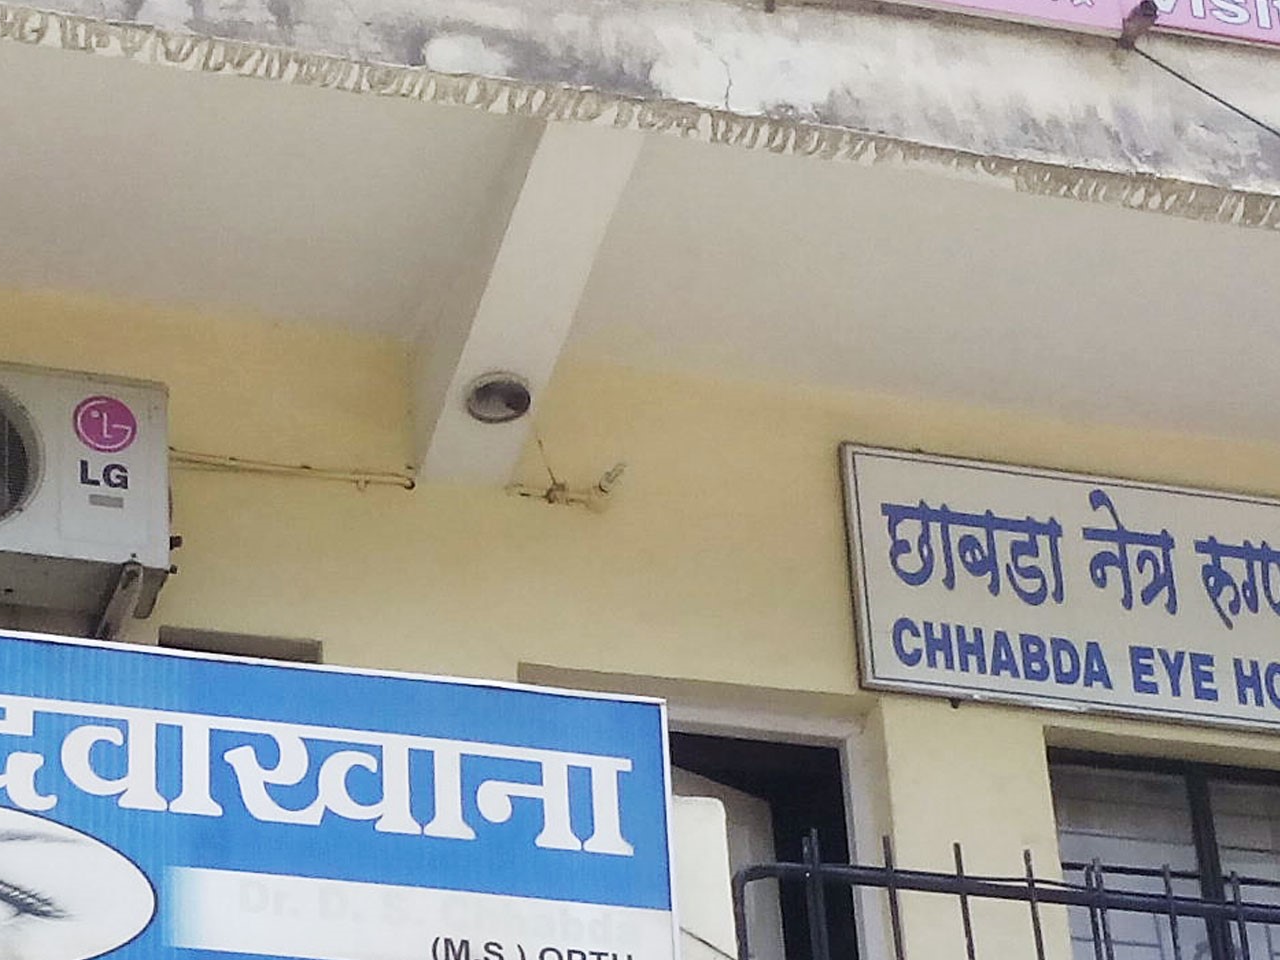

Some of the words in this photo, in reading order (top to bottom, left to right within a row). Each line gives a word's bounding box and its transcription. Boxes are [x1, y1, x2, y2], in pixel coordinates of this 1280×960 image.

[79, 459, 130, 490] LG
[881, 499, 1064, 606] छाबडा
[1083, 489, 1179, 615] नेत्र
[892, 617, 1113, 691] CHHABDA
[1129, 645, 1219, 702] EYE
